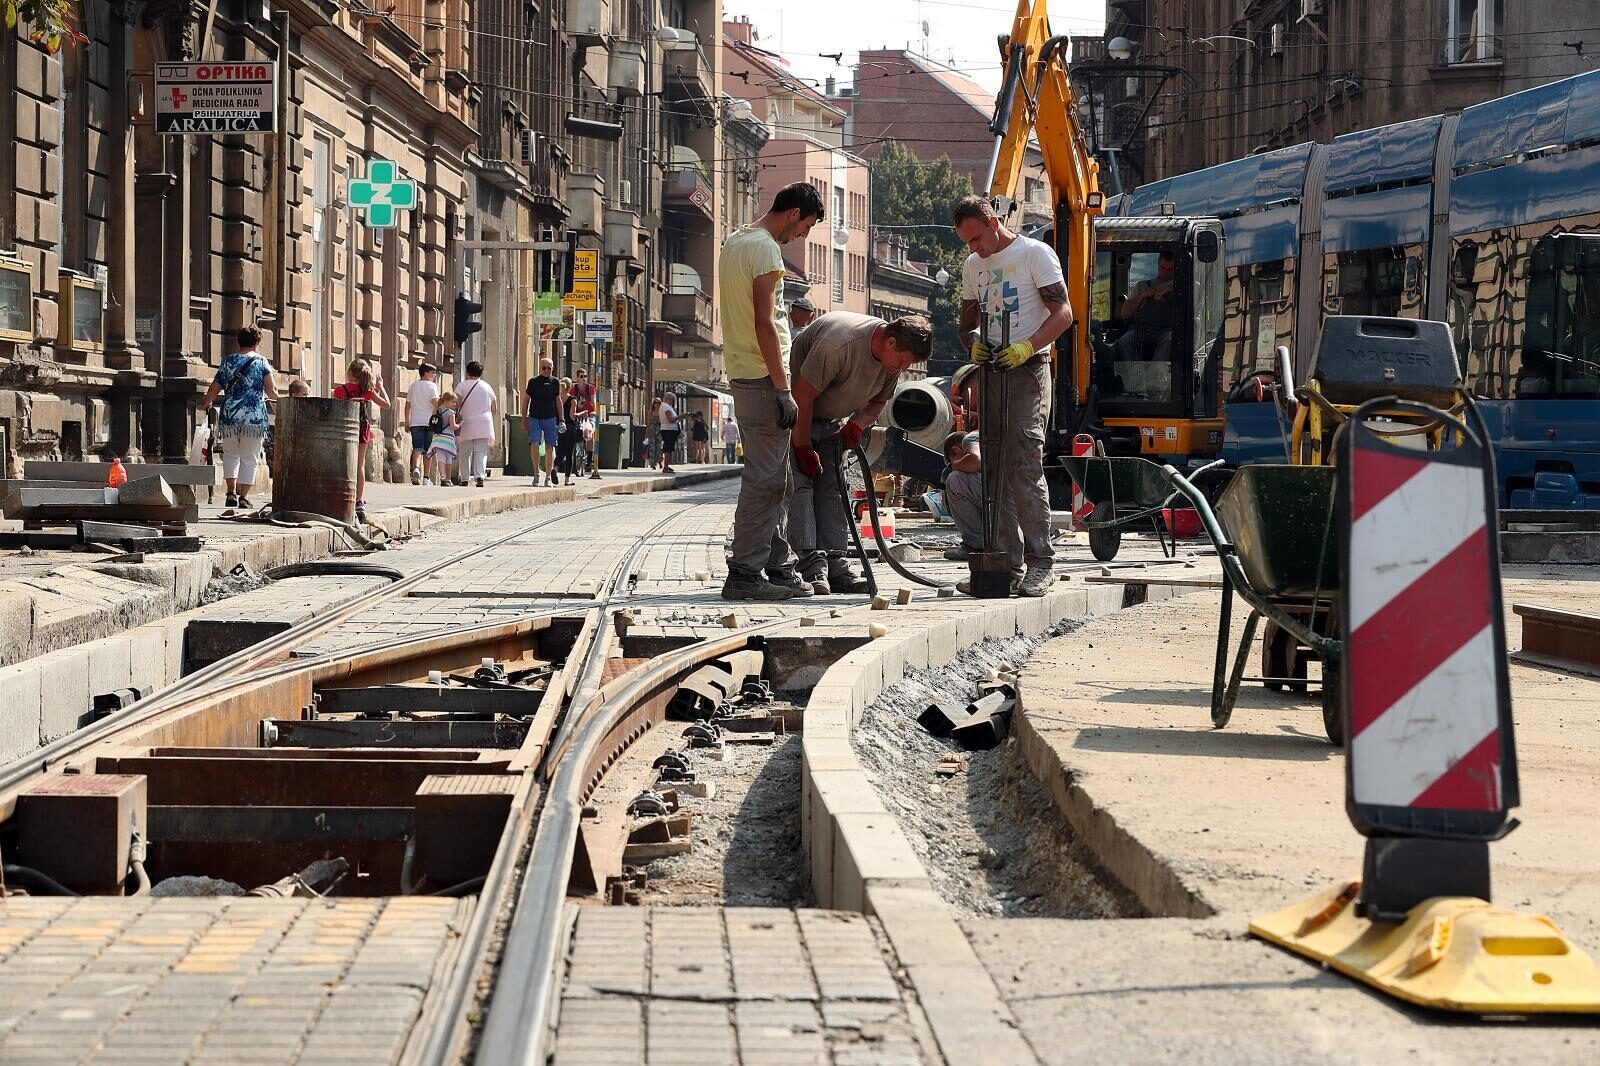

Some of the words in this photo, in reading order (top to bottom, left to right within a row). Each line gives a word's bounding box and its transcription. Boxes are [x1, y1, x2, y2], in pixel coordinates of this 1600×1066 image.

[196, 66, 266, 80] OPTIKA
[215, 87, 263, 96] POLIKLINIKA
[192, 99, 234, 108] MEDICINA
[236, 99, 260, 108] RADA
[1346, 347, 1432, 367] WACKER
